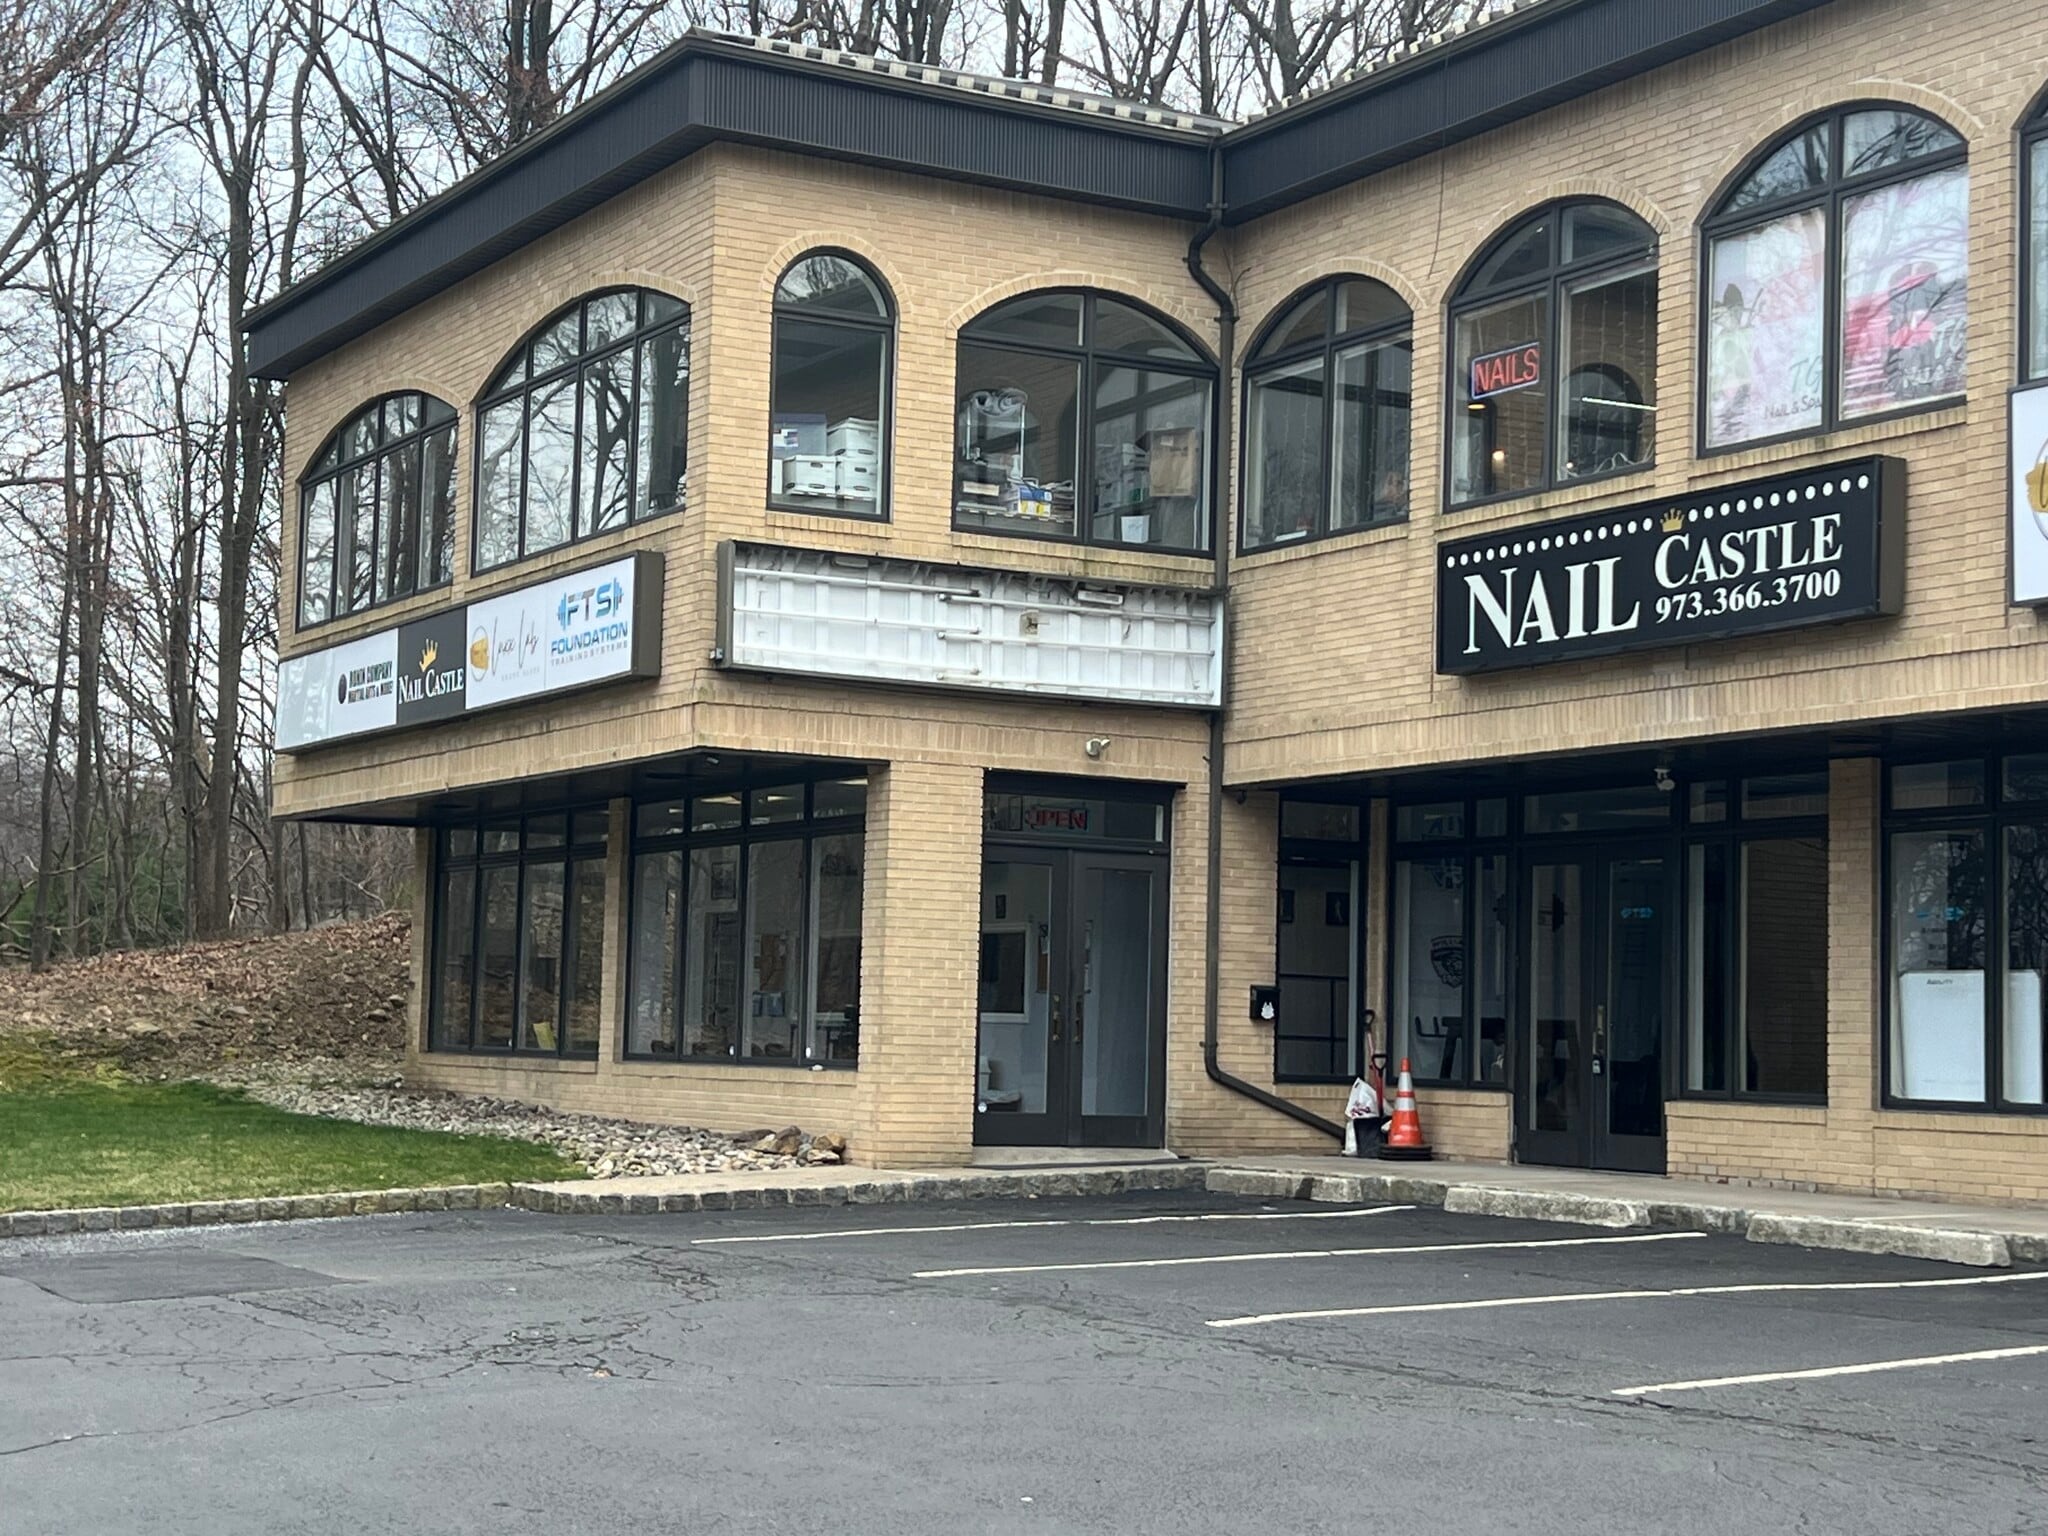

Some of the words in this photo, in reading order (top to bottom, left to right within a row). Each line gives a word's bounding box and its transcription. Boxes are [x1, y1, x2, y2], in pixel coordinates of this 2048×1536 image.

[1474, 348, 1540, 393] NAILS
[567, 583, 612, 626] FTS
[1462, 556, 1641, 655] NAIL
[1654, 512, 1844, 590] CASTLE
[1654, 568, 1842, 624] 973.366.3700
[551, 621, 629, 656] FOUNDATION
[398, 674, 425, 705] NAIL
[425, 668, 464, 698] CASTLE
